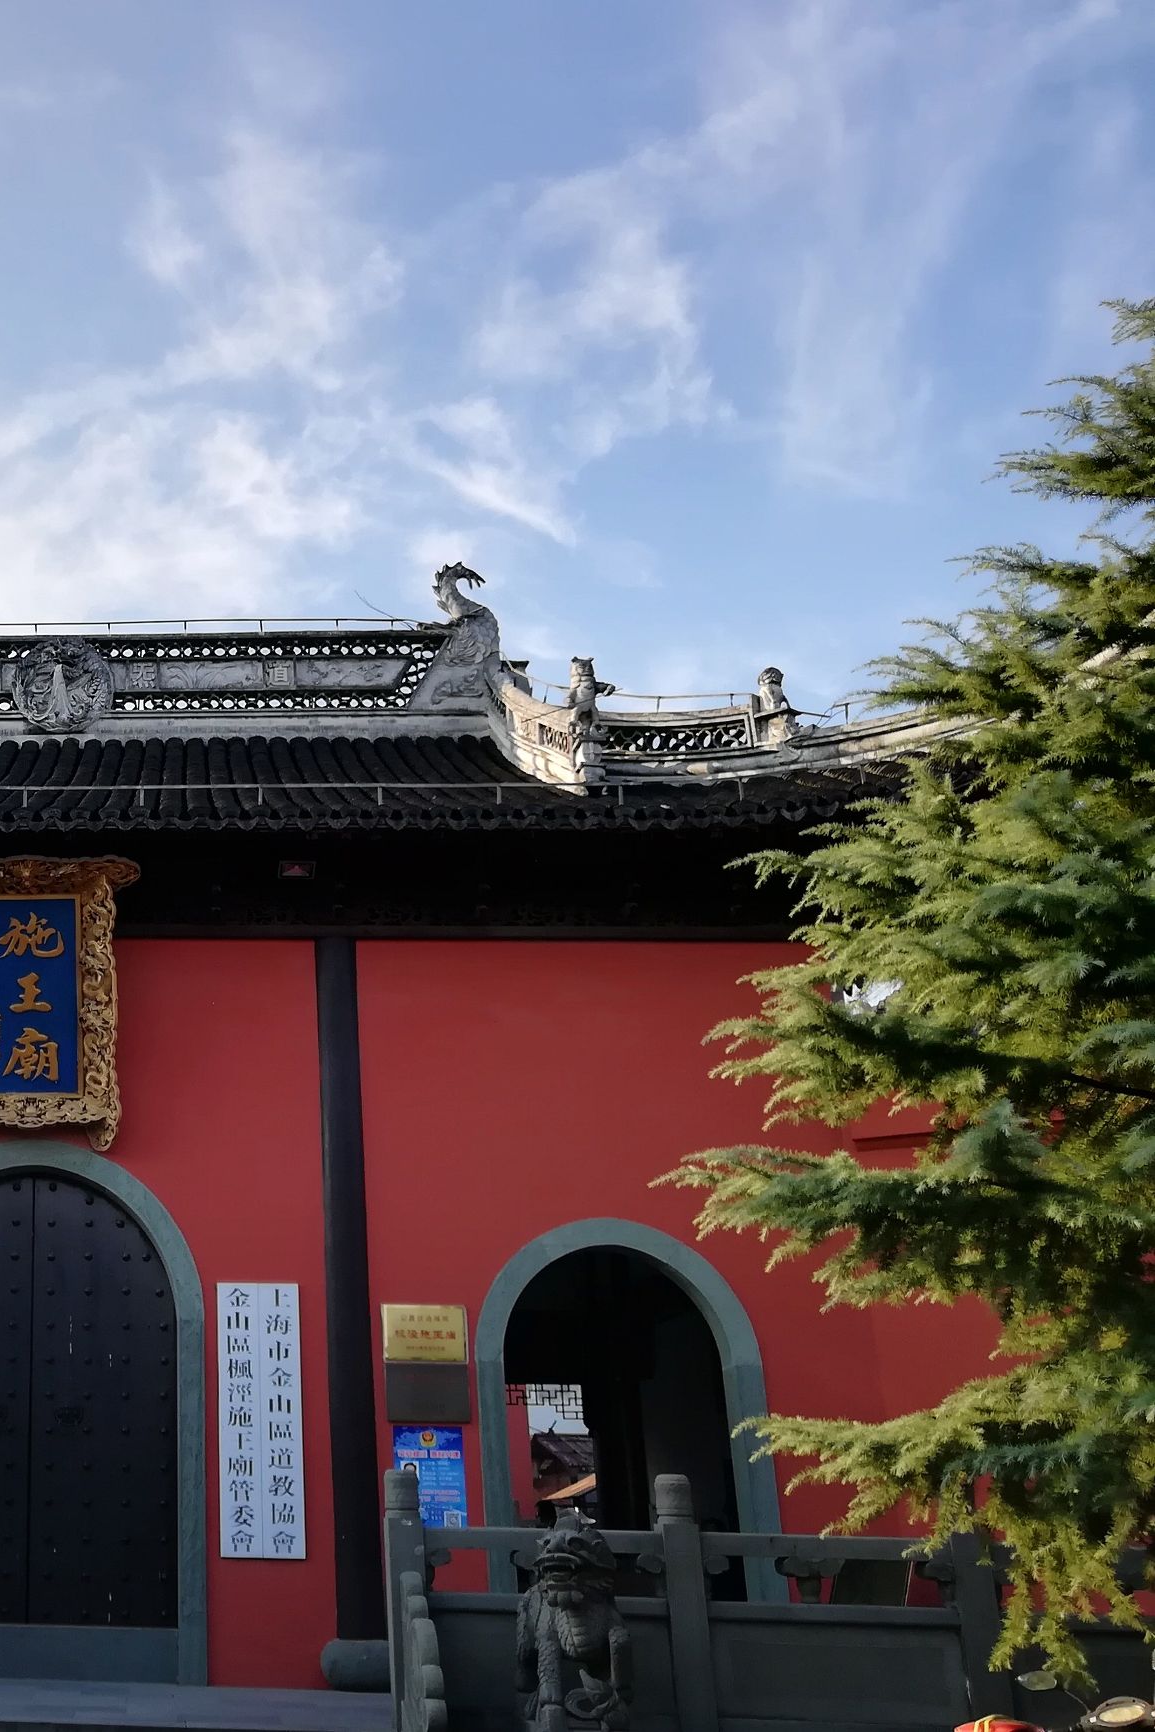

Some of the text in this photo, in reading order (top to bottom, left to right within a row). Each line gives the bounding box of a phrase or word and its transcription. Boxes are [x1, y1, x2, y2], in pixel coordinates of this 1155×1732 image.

[266, 661, 291, 688] 道
[226, 1287, 255, 1553] 金山區楓涇施王廟管委會
[265, 1287, 296, 1554] 上海市金山區道教協會
